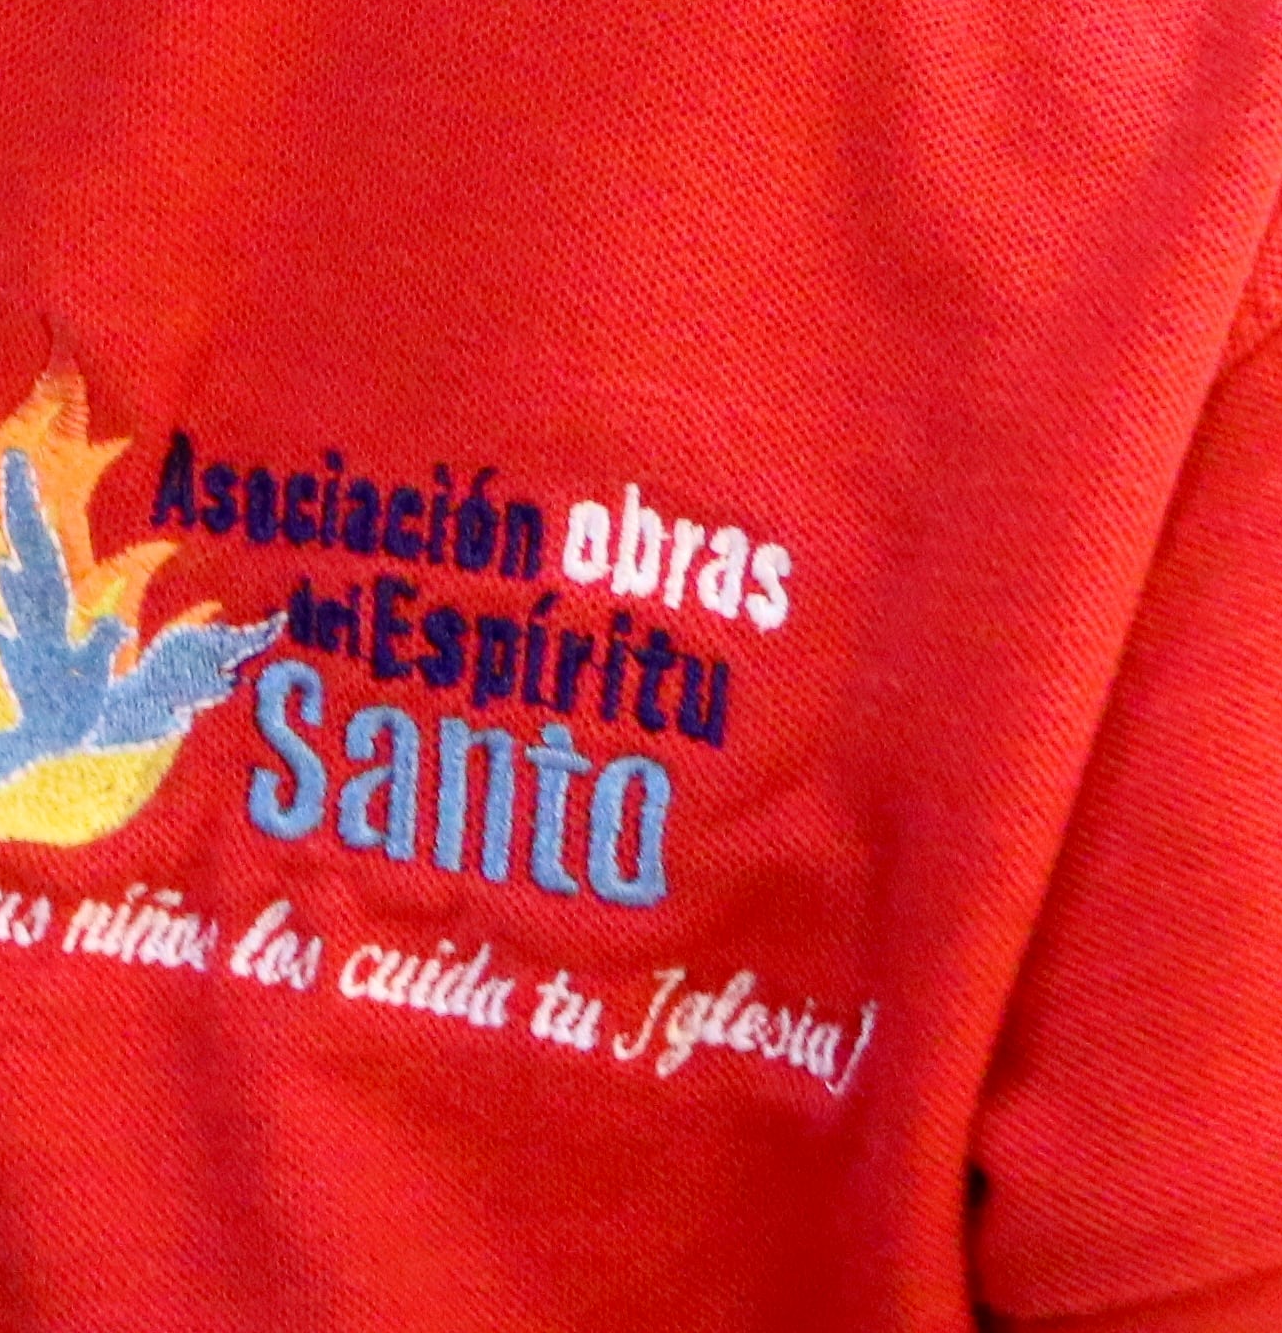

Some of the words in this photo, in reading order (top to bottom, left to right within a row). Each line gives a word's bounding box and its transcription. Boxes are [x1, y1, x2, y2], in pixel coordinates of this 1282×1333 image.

[149, 429, 545, 581] Asociación
[562, 483, 792, 633] obras
[371, 573, 728, 748] Espíritu
[247, 660, 672, 908] Santo
[61, 882, 218, 971] niños
[229, 899, 323, 990] los
[337, 939, 514, 1028] cuida
[530, 968, 603, 1050] tu
